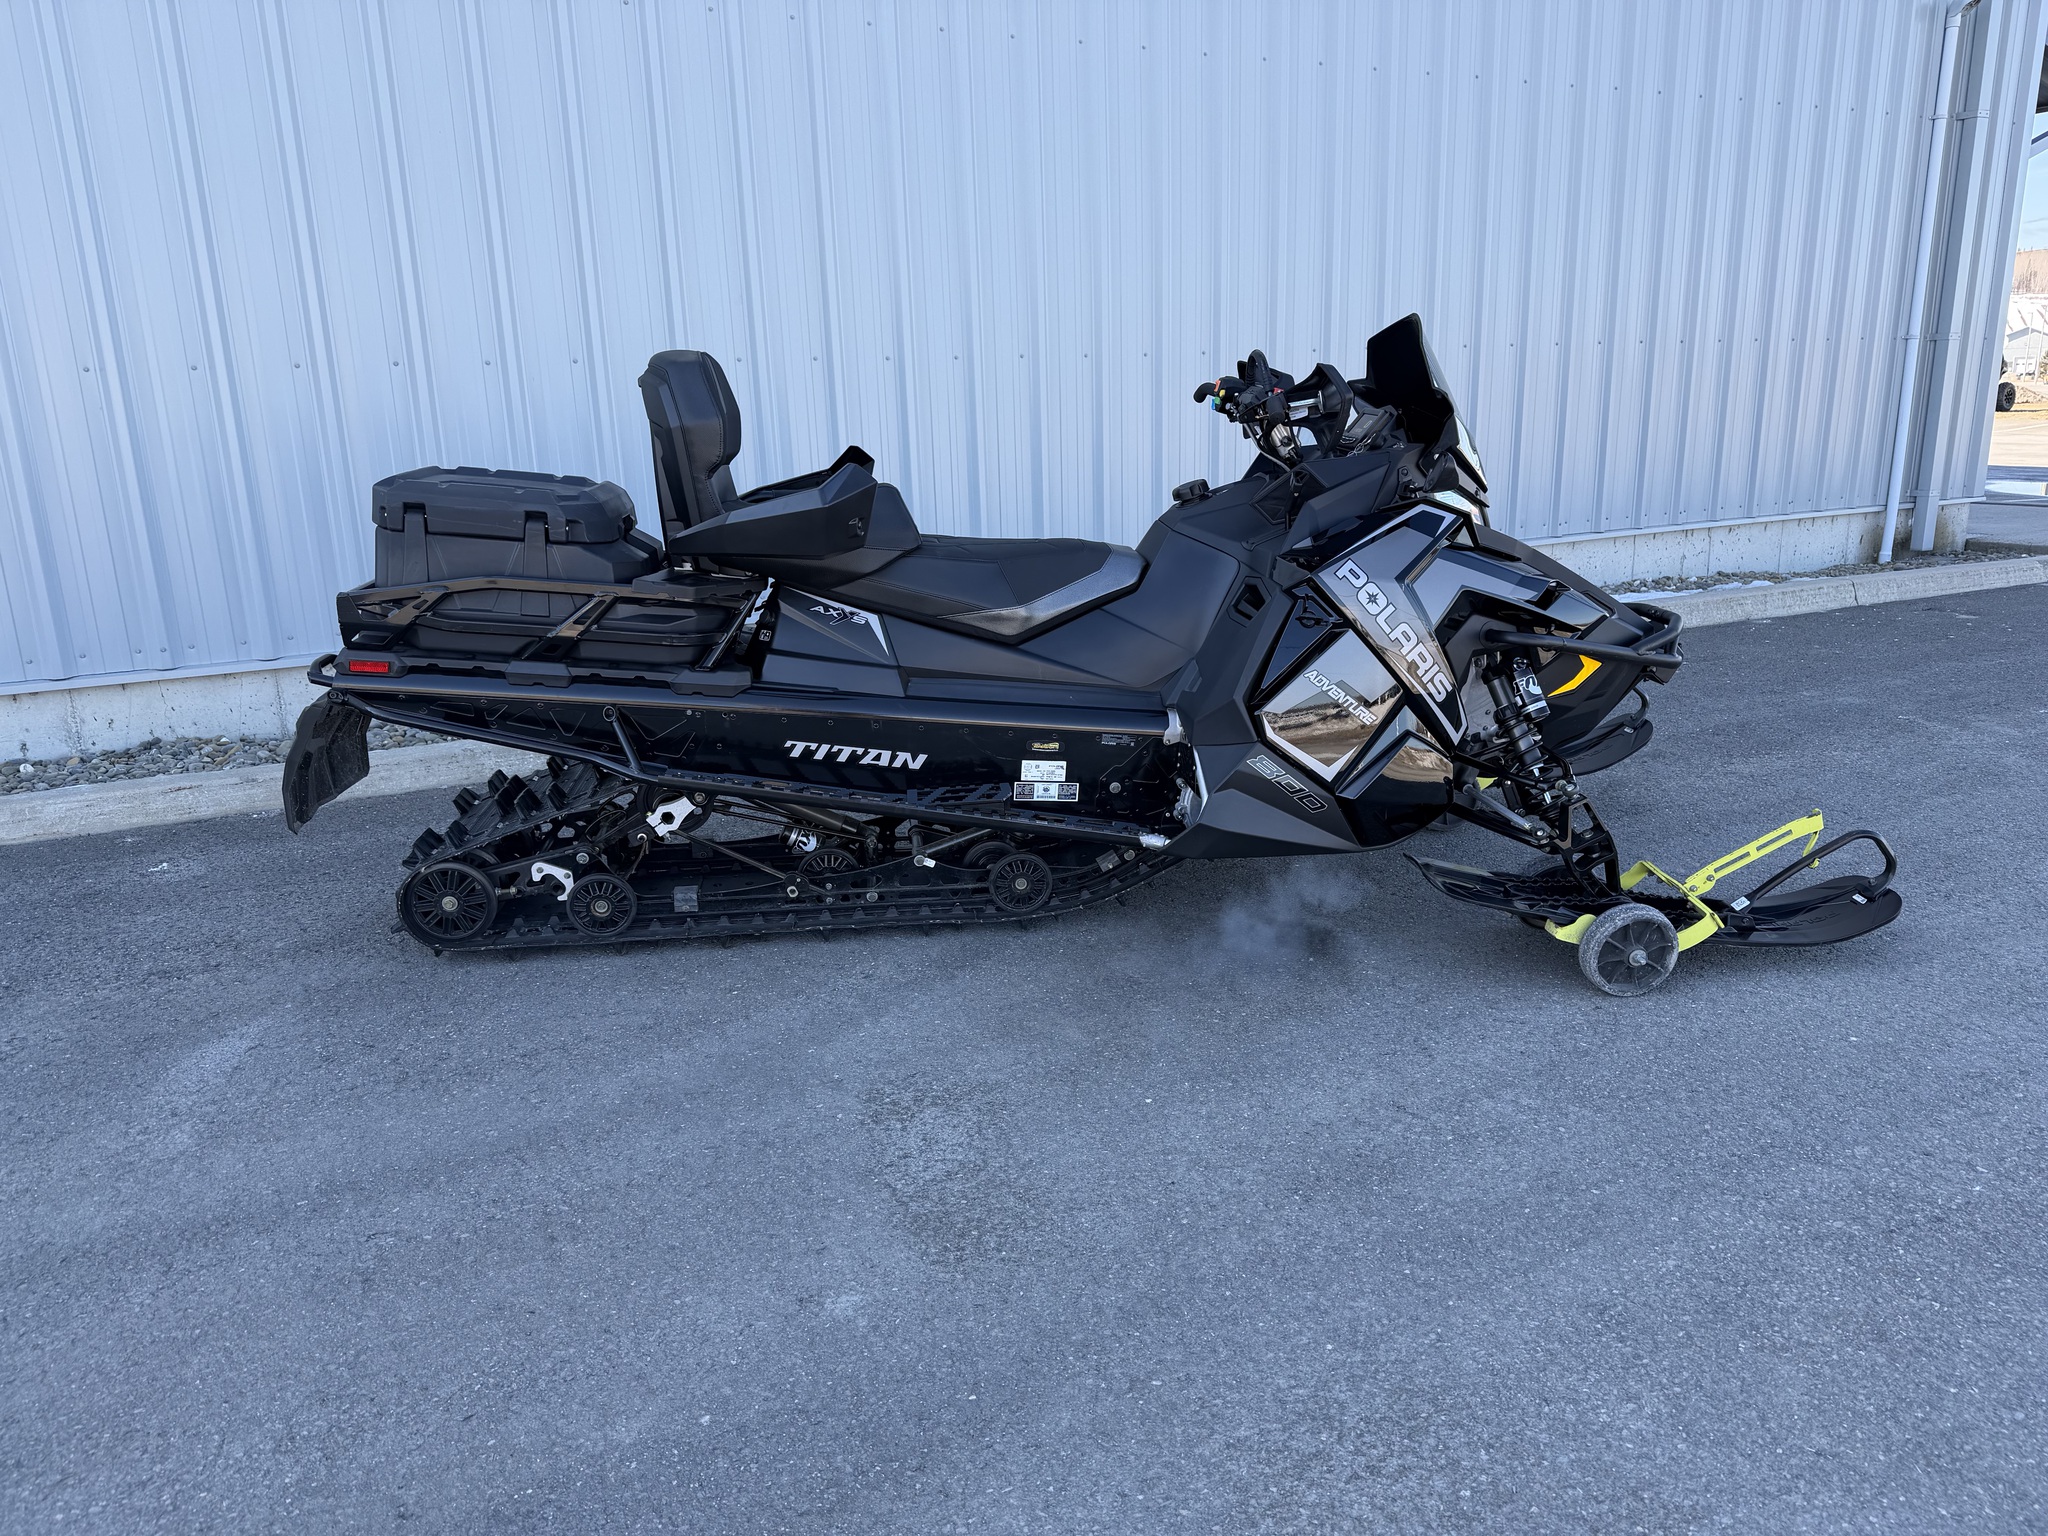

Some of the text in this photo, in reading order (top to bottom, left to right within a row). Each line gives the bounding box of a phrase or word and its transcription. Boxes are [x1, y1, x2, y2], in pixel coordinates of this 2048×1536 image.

[1333, 557, 1453, 703] POLARIS
[1303, 669, 1378, 725] ADVENTURE
[783, 740, 928, 770] TITAN
[1246, 754, 1328, 813] 800
